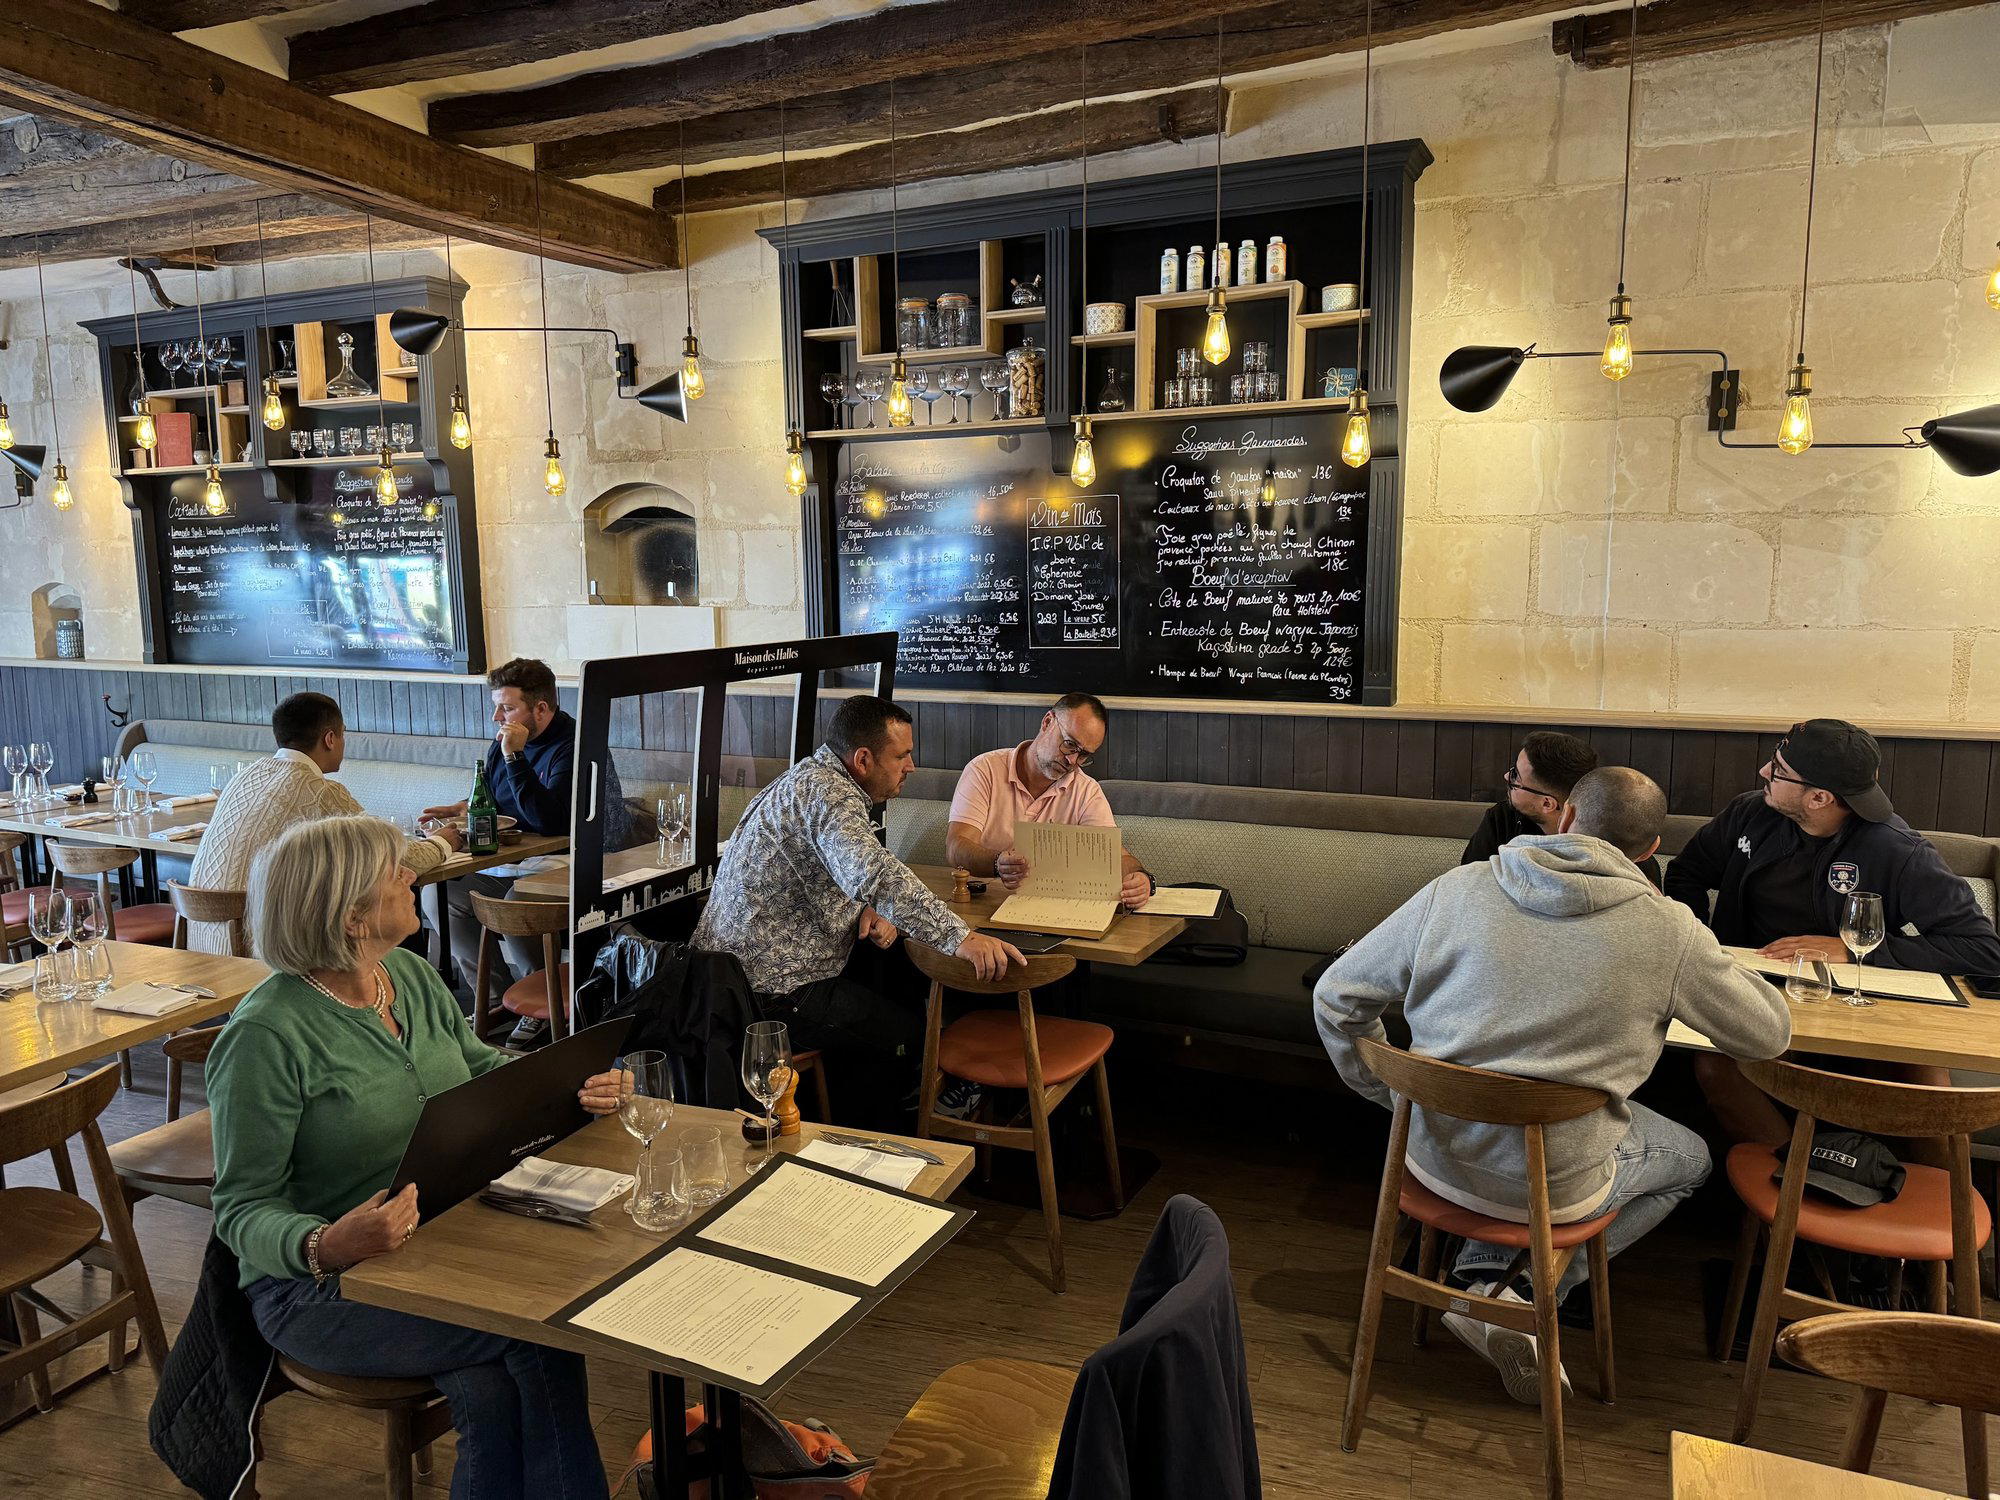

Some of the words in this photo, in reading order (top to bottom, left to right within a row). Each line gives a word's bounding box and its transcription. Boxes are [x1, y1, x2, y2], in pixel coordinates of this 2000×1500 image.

[1211, 469, 1221, 485] de
[1228, 468, 1262, 488] jambon
[1312, 465, 1333, 480] 13€
[987, 482, 1015, 497] 16,50€
[1203, 486, 1224, 500] Sauce
[365, 495, 372, 507] de
[1159, 502, 1199, 515] Couteaux
[1204, 502, 1215, 513] de
[1216, 502, 1234, 512] mer
[1262, 499, 1274, 507] au
[1030, 501, 1059, 527] Vin
[1071, 502, 1102, 525] Mois
[1336, 506, 1352, 517] 13€
[349, 531, 359, 543] gras
[391, 527, 397, 538] de
[885, 528, 893, 537] de
[1156, 524, 1186, 546] Foie
[1191, 534, 1213, 550] gras
[1252, 523, 1277, 544] figues
[1283, 525, 1297, 536] de
[1030, 535, 1063, 551] I.G.P
[1066, 534, 1090, 551] Val
[1091, 535, 1104, 550] de
[1157, 546, 1193, 560] provence
[1201, 542, 1233, 558] pochées
[1261, 542, 1277, 551] vin
[1281, 538, 1312, 549] chaud
[1317, 536, 1355, 549] Chinon
[1320, 557, 1349, 572] 18€
[1032, 579, 1055, 591] 100%
[1192, 565, 1229, 590] Boeuf
[1231, 569, 1294, 588] d'exception
[1029, 591, 1073, 602] Domaine
[1159, 588, 1181, 608] Côte
[1186, 593, 1199, 608] de
[1203, 590, 1233, 612] Boeuf
[1236, 589, 1273, 606] maturée
[1294, 592, 1316, 608] jours
[1336, 589, 1361, 602] 100€
[1072, 600, 1105, 612] Brumes
[1272, 603, 1292, 617] Race
[1298, 603, 1340, 616] Holstein
[999, 612, 1018, 624] 6,50€
[1064, 610, 1072, 622] Le
[1092, 613, 1106, 624] 5€
[1064, 625, 1072, 639] La
[1100, 627, 1117, 638] 23€
[1161, 620, 1217, 637] Entrecôte
[1220, 621, 1233, 637] de
[1239, 620, 1271, 642] Boeuf
[1198, 637, 1254, 658] Kagoshima
[1258, 641, 1290, 658] grade
[1293, 644, 1303, 654] 5
[1310, 642, 1322, 659] 2p
[1327, 643, 1351, 658] 500g
[734, 651, 762, 666] Maison
[762, 649, 776, 662] des
[776, 647, 799, 661] Halles
[1323, 656, 1353, 668] 129€
[919, 664, 927, 673] de
[975, 662, 984, 672] de
[1158, 664, 1186, 682] Hampe
[1189, 668, 1198, 677] de
[1309, 671, 1319, 681] des
[1329, 686, 1351, 700] 39€
